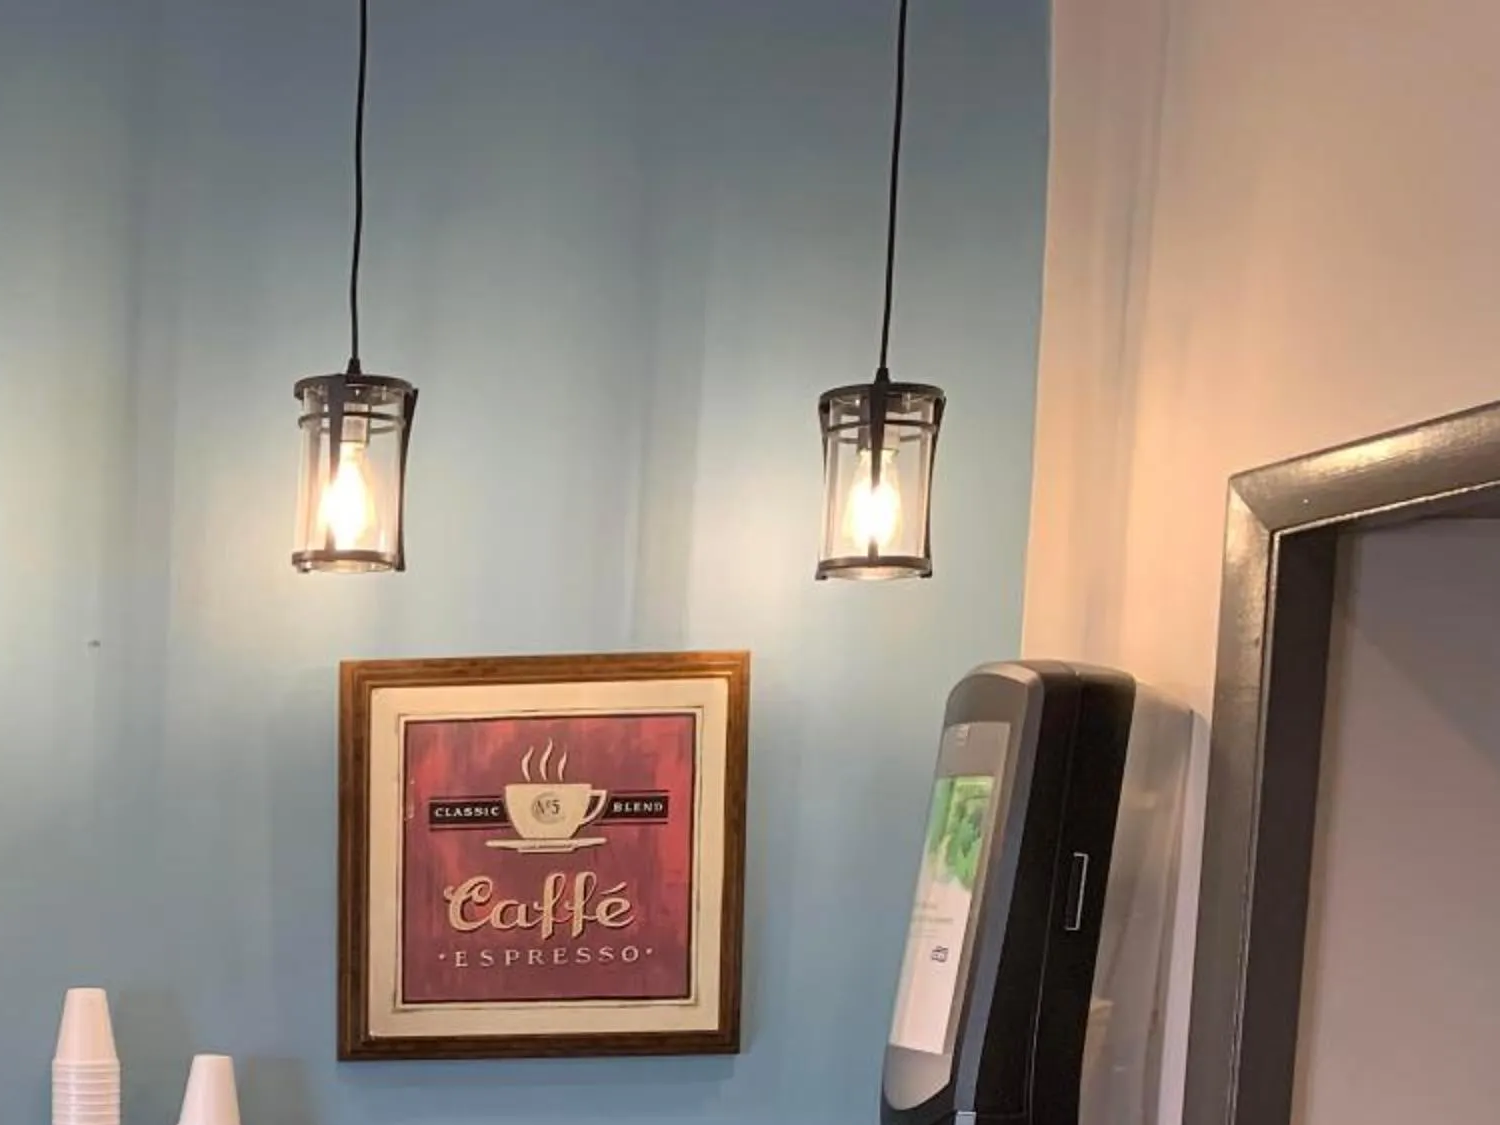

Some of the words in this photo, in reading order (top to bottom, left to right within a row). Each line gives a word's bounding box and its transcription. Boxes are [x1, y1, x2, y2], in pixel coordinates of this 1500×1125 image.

[434, 806, 499, 818] CLASSIC
[612, 802, 664, 814] BLEND
[443, 871, 635, 940] Caffé
[454, 945, 640, 968] ESPRESSO
